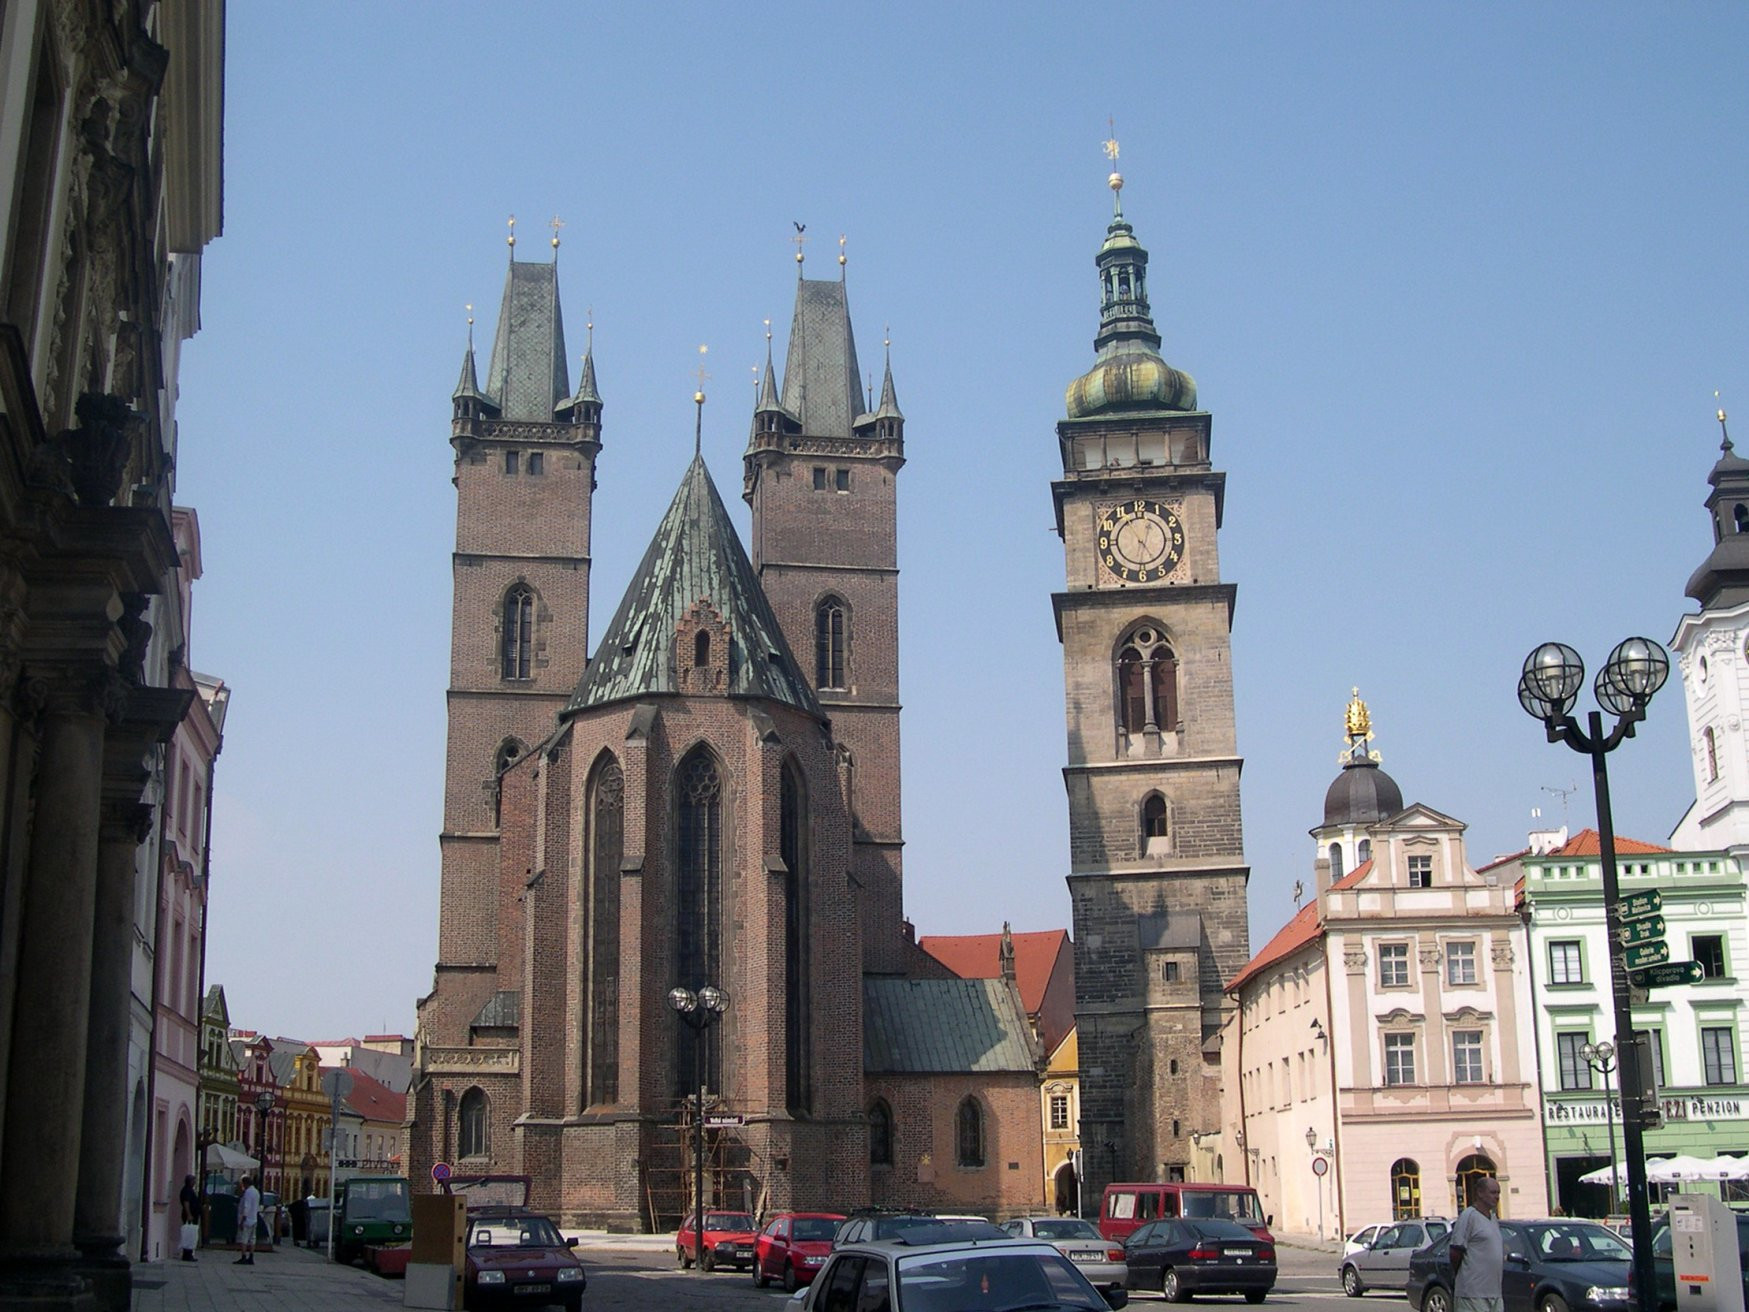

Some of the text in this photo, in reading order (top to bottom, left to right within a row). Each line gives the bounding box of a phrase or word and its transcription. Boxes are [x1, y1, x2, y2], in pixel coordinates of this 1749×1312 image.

[1116, 506, 1125, 517] 11
[1134, 501, 1145, 511] 12
[1155, 504, 1160, 515] 1
[1103, 520, 1114, 531] 10
[1169, 516, 1177, 527] 2
[1100, 537, 1108, 549] 9
[1174, 534, 1182, 545] 3
[1106, 555, 1114, 566] 8
[1170, 550, 1178, 562] 4
[1121, 568, 1128, 579] 7
[1139, 570, 1147, 582] 6
[1158, 565, 1166, 576] 5
[1548, 1105, 1621, 1119] RESTAURAE
[1692, 1101, 1741, 1115] PENZION
